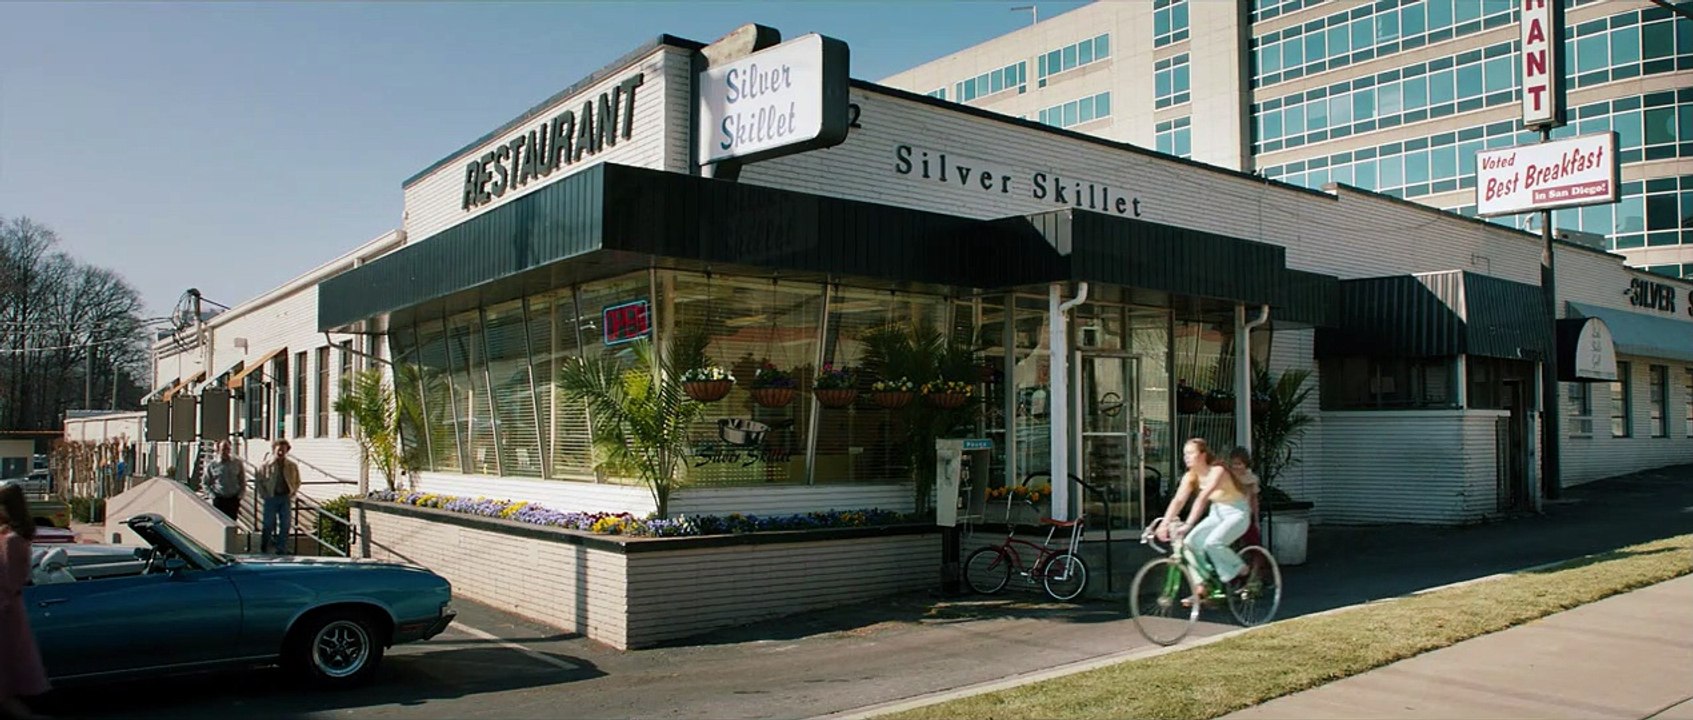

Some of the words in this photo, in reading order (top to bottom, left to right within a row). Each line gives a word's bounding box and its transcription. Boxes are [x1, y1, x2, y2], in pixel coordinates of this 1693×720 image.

[726, 63, 791, 103] Silver
[462, 73, 644, 211] RESTAURANT
[720, 101, 796, 150] Skillet
[896, 145, 1012, 193] Silver
[1033, 173, 1141, 217] Skillet
[1482, 152, 1516, 170] Voted
[1485, 172, 1519, 201] Best
[1524, 146, 1602, 189] Breakfast
[1549, 188, 1568, 198] San
[1630, 277, 1675, 313] SILVER
[695, 453, 741, 468] Silver
